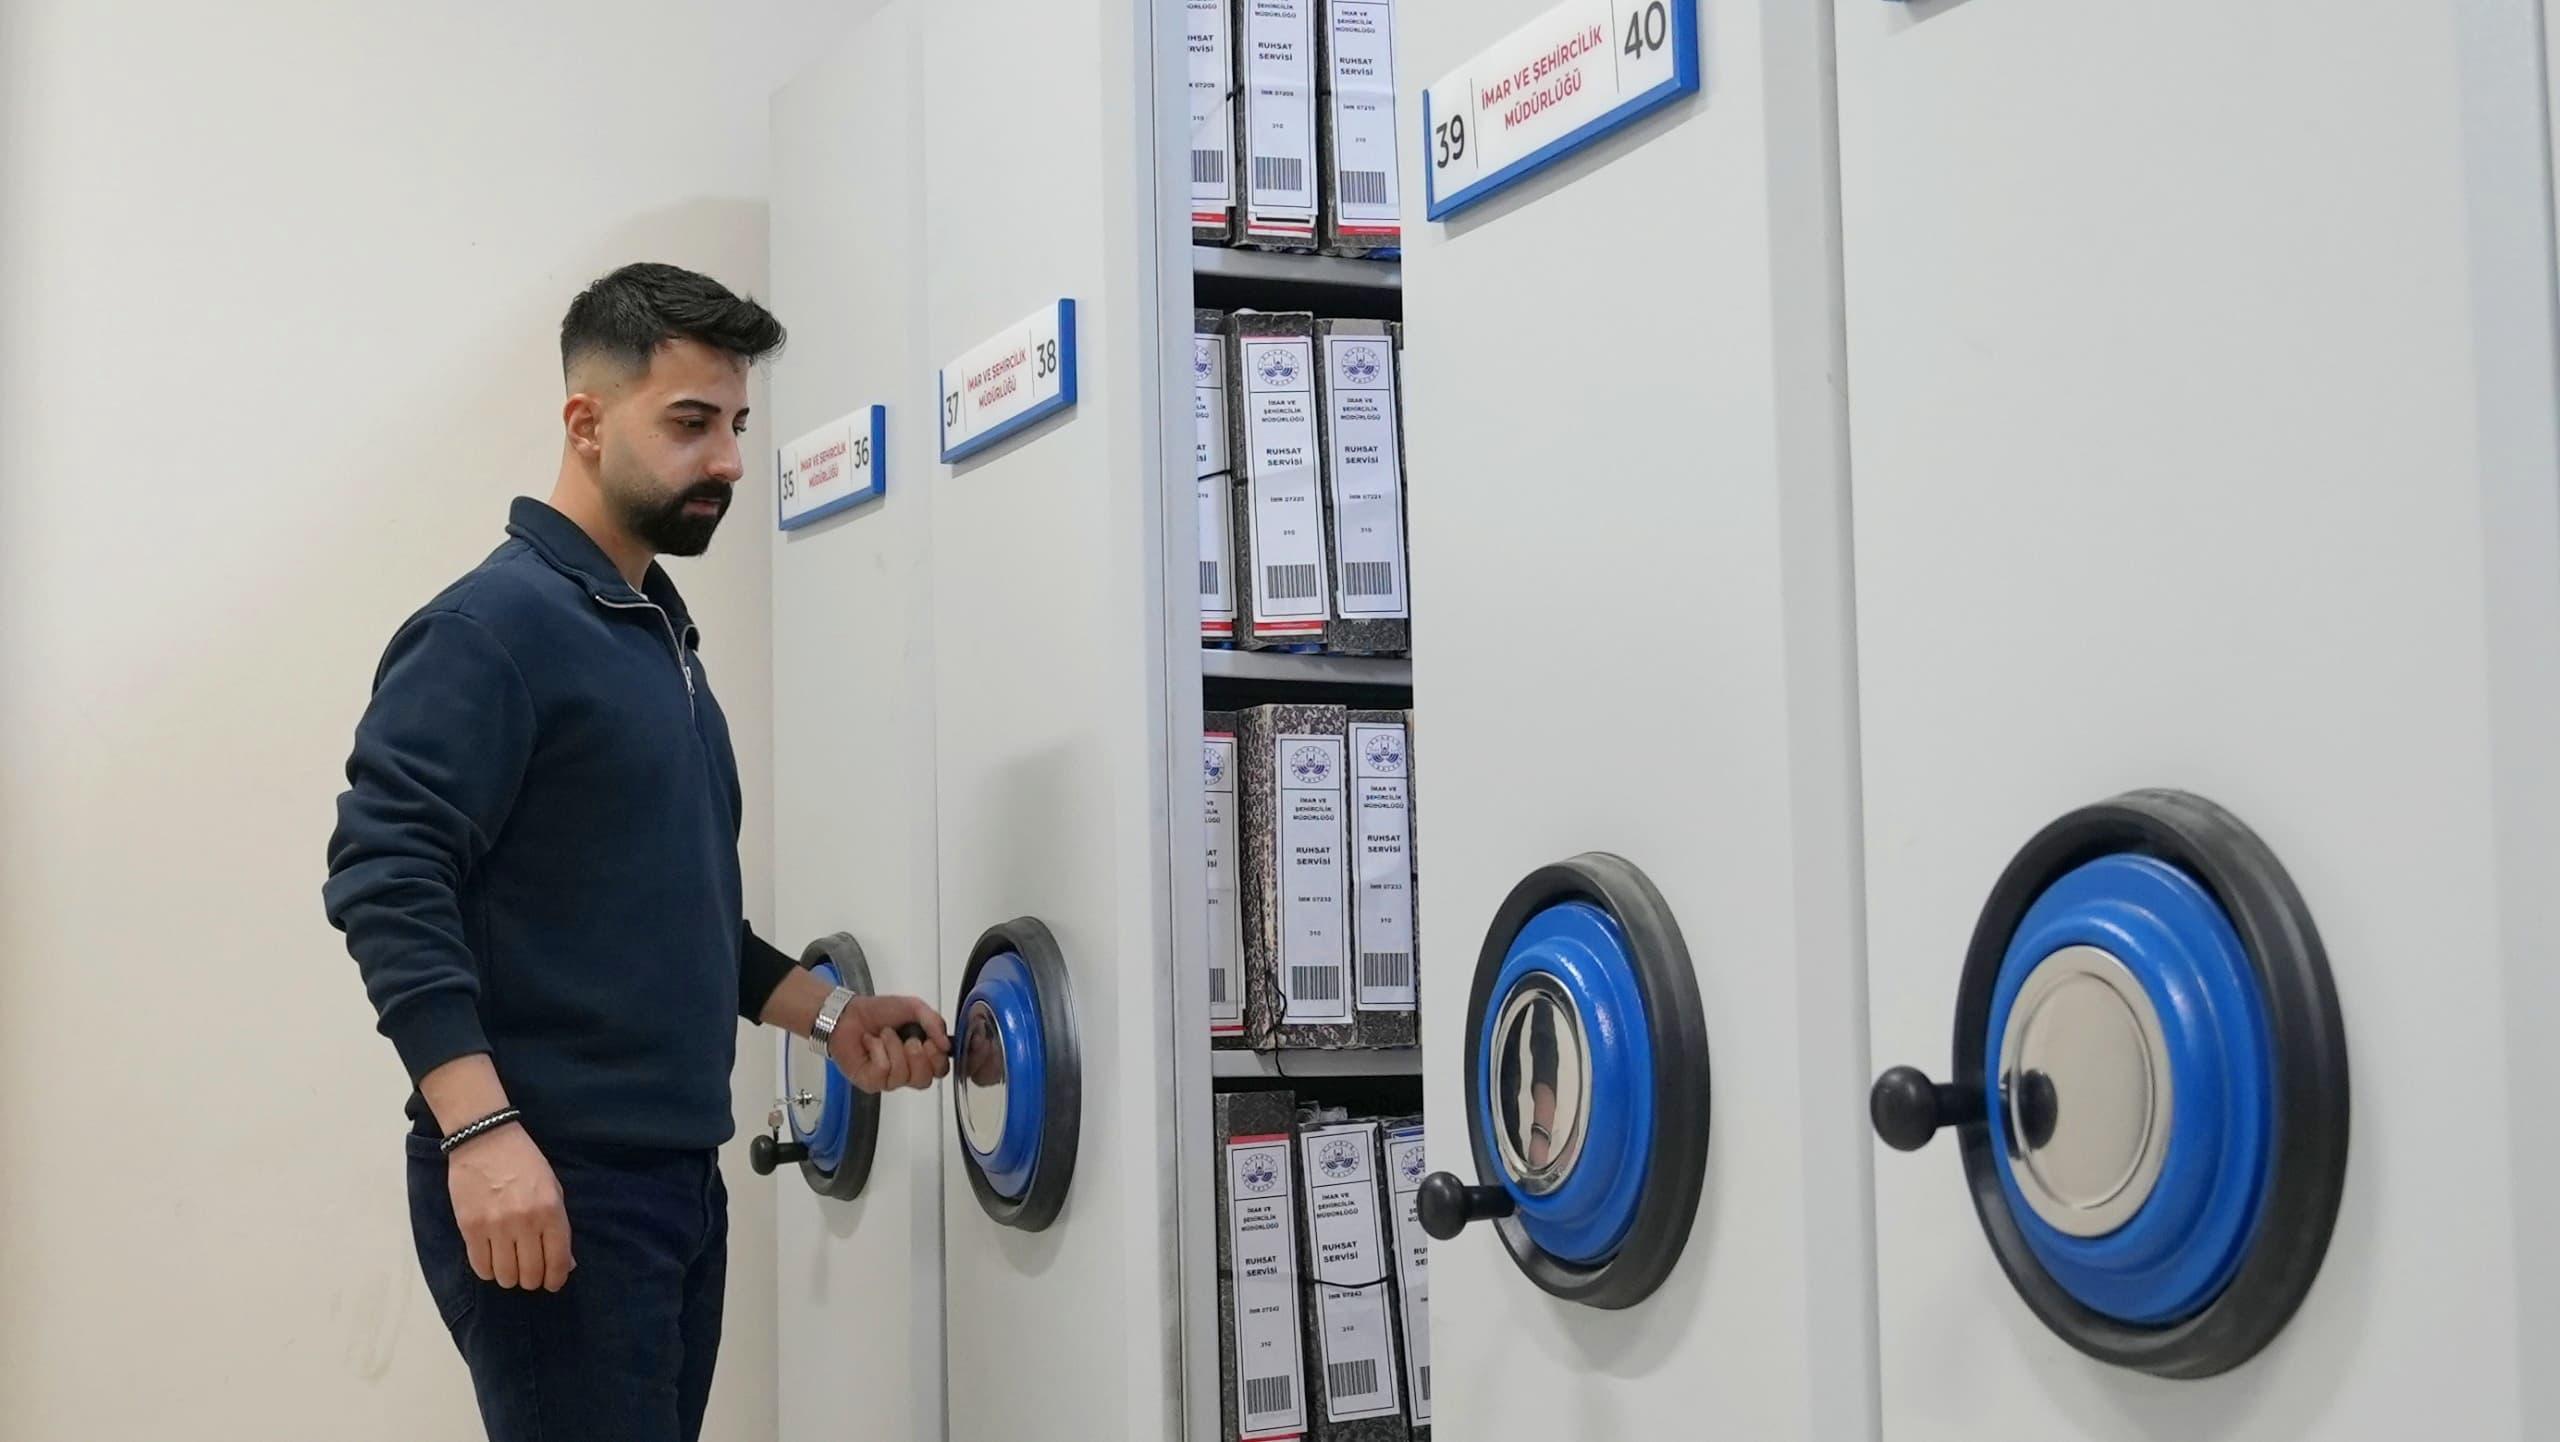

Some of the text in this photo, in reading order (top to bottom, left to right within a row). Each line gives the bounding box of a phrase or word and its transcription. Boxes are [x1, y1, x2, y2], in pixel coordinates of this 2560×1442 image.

[1624, 1, 1666, 60] 40
[1189, 45, 1214, 53] RVİSİ
[1258, 42, 1292, 50] RUHSAT
[1259, 53, 1293, 61] SERVİSİ
[1339, 57, 1373, 65] RUHSAT
[1340, 68, 1373, 76] SERVİSİ
[1481, 24, 1603, 110] İMAR VE ŞEHİRCİLİK
[1504, 68, 1582, 130] MÜDÜRLÜĞÜ
[1435, 114, 1465, 169] 39
[1036, 339, 1057, 378] 38
[967, 347, 1027, 393] İMAR VE ŞEHİRCİLİK
[978, 375, 1017, 408] MÜDÜRLÜĞÜ
[945, 391, 959, 428] 37
[854, 436, 870, 469] 36
[1266, 447, 1302, 455] RUHSAT
[1267, 457, 1303, 466] SERVİSİ
[1345, 456, 1379, 464] SERVİSİ
[782, 470, 794, 500] 35
[1367, 834, 1401, 842] RUHSAT
[1296, 846, 1331, 854] RUHSAT
[1367, 845, 1401, 853] SERVİSİ
[1296, 857, 1331, 865] SERVİSİ
[1322, 1241, 1357, 1251] RUHSAT
[1245, 1255, 1277, 1265] RUHSAT
[1323, 1251, 1358, 1263] SERVİSİ
[1246, 1266, 1278, 1277] SERVİSİ
